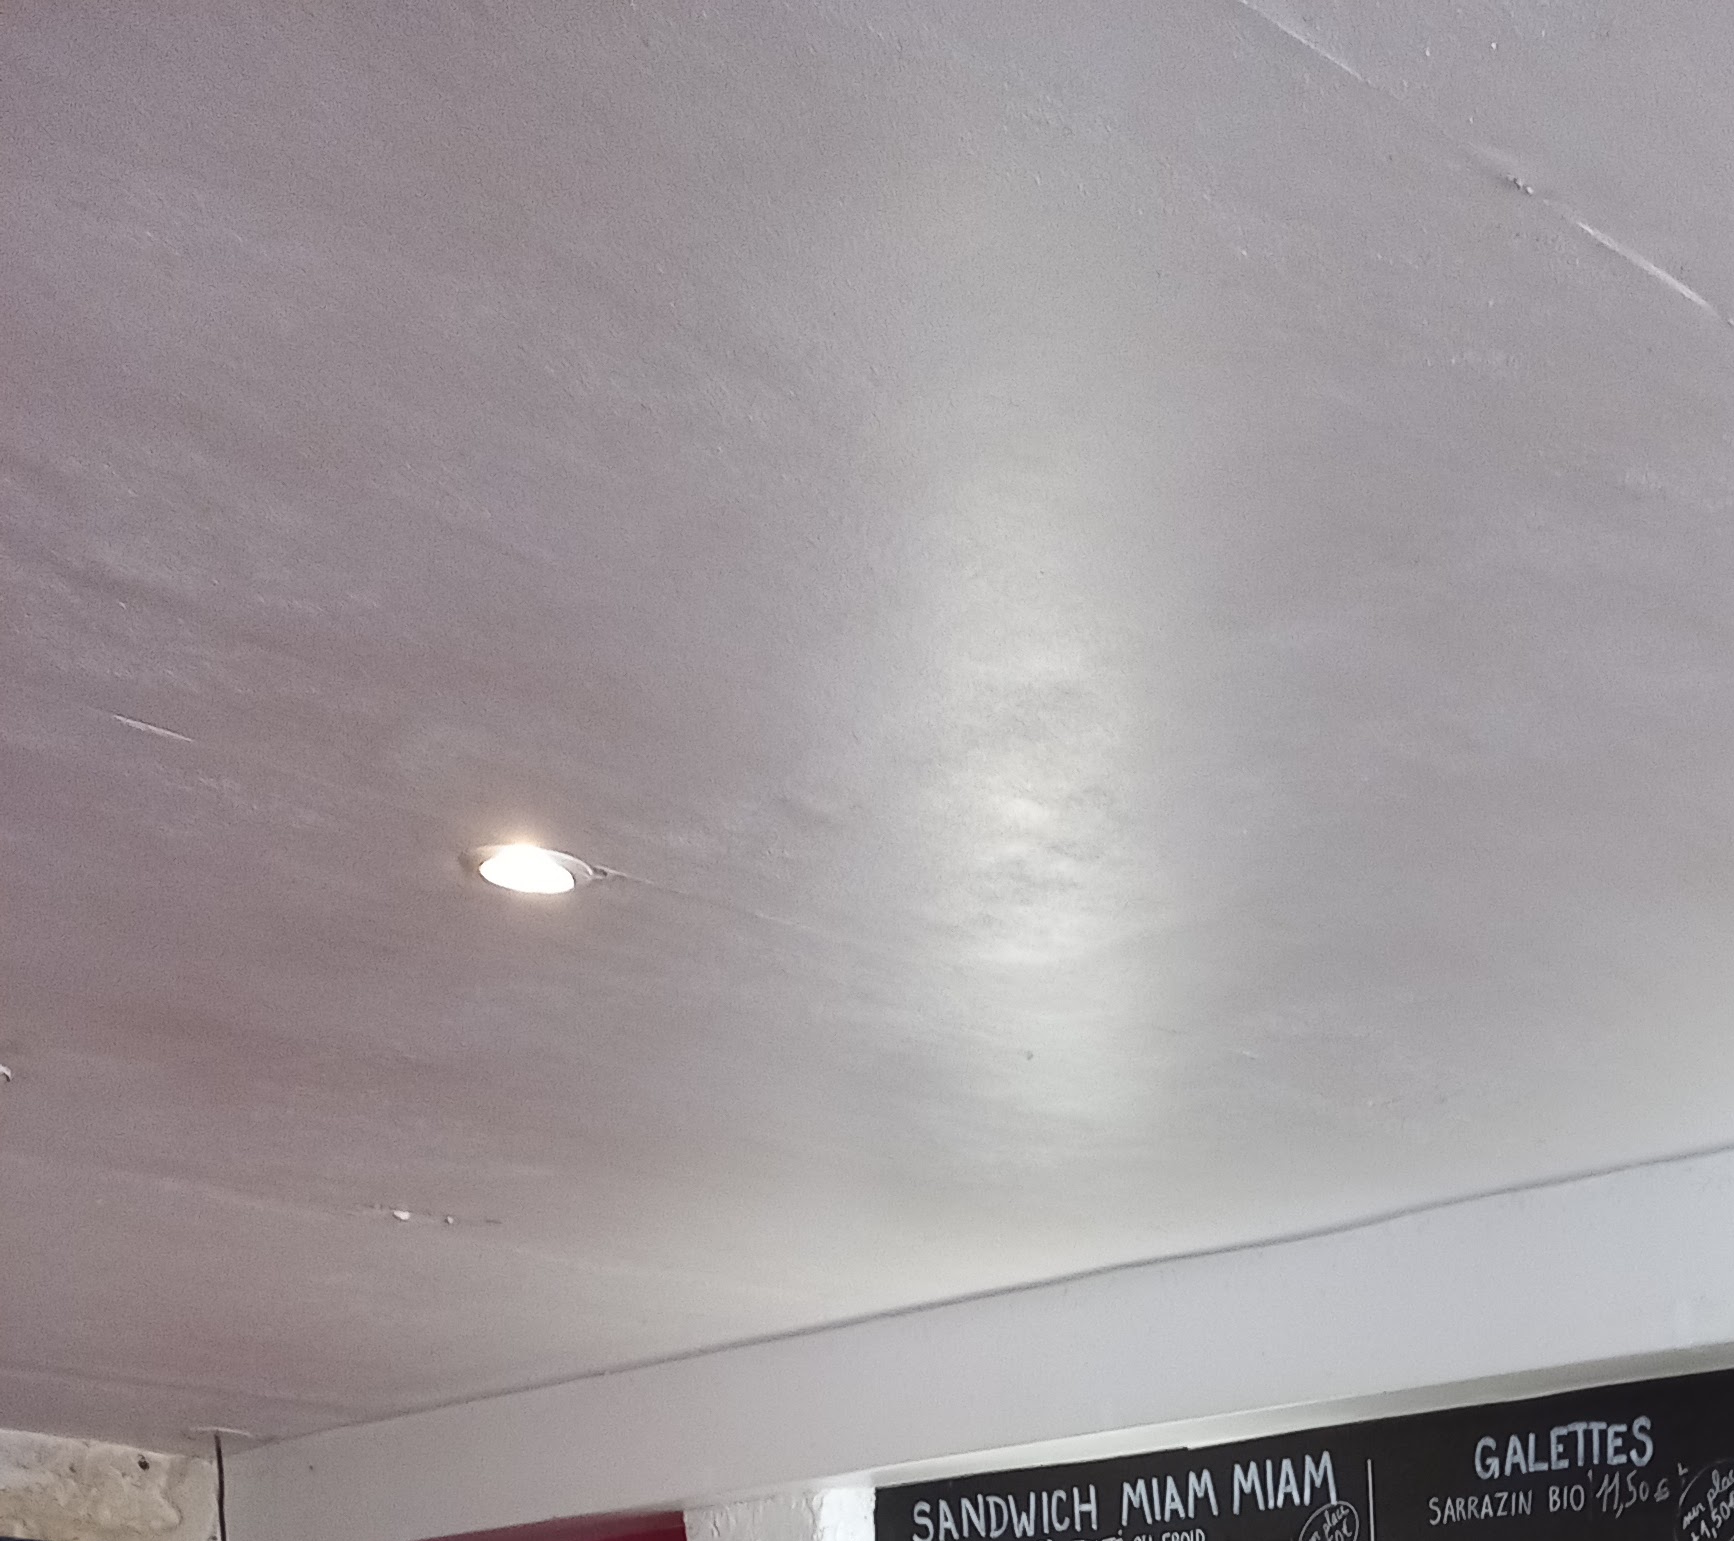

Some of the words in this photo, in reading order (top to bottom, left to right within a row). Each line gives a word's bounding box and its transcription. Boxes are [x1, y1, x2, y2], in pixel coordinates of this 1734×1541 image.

[1474, 1415, 1654, 1480] GALETTES
[1122, 1469, 1218, 1526] MIAM
[1232, 1450, 1338, 1514] MIAM
[1429, 1490, 1532, 1525] SARRAZIN
[1549, 1485, 1584, 1512] BIO
